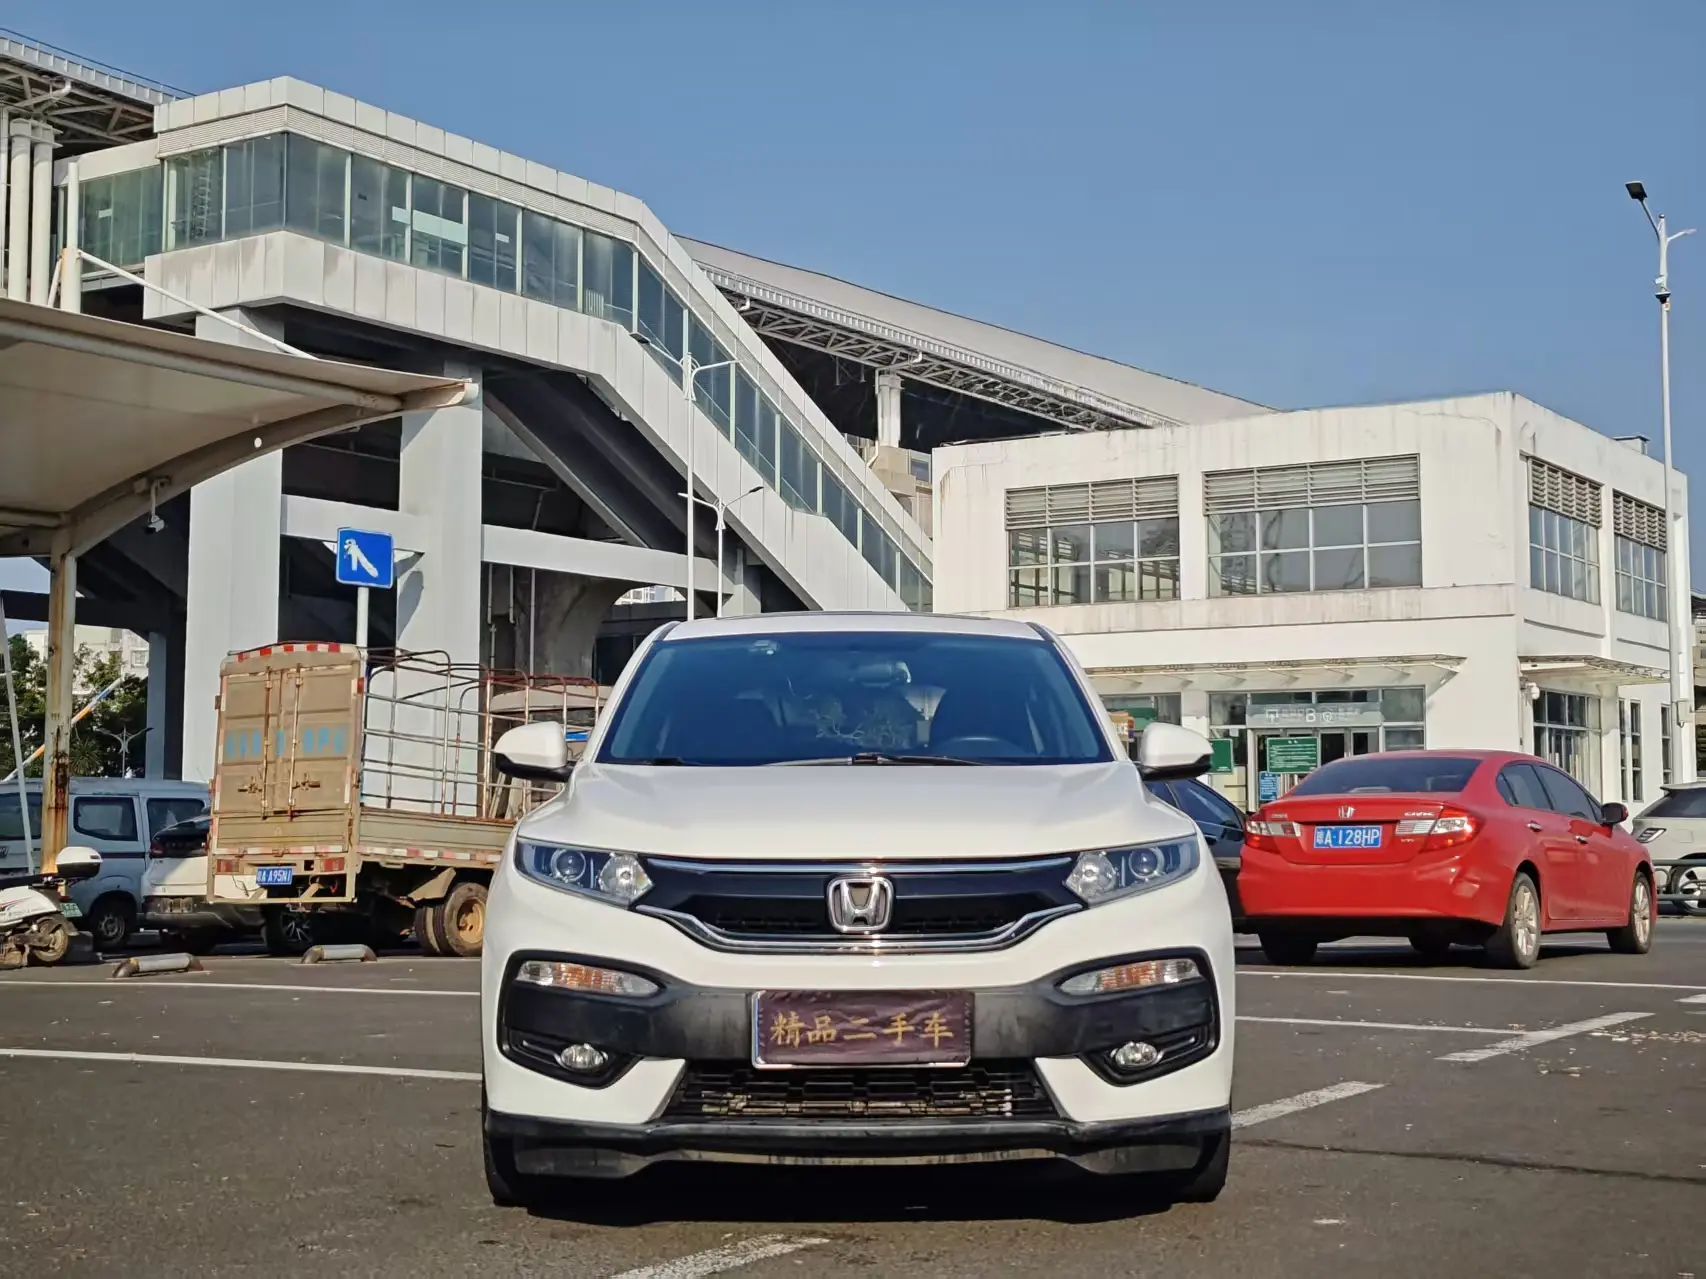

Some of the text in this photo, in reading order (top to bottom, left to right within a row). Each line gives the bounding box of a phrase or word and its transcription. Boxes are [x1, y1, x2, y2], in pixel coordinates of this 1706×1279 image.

[770, 1010, 953, 1048] 精品二手车
